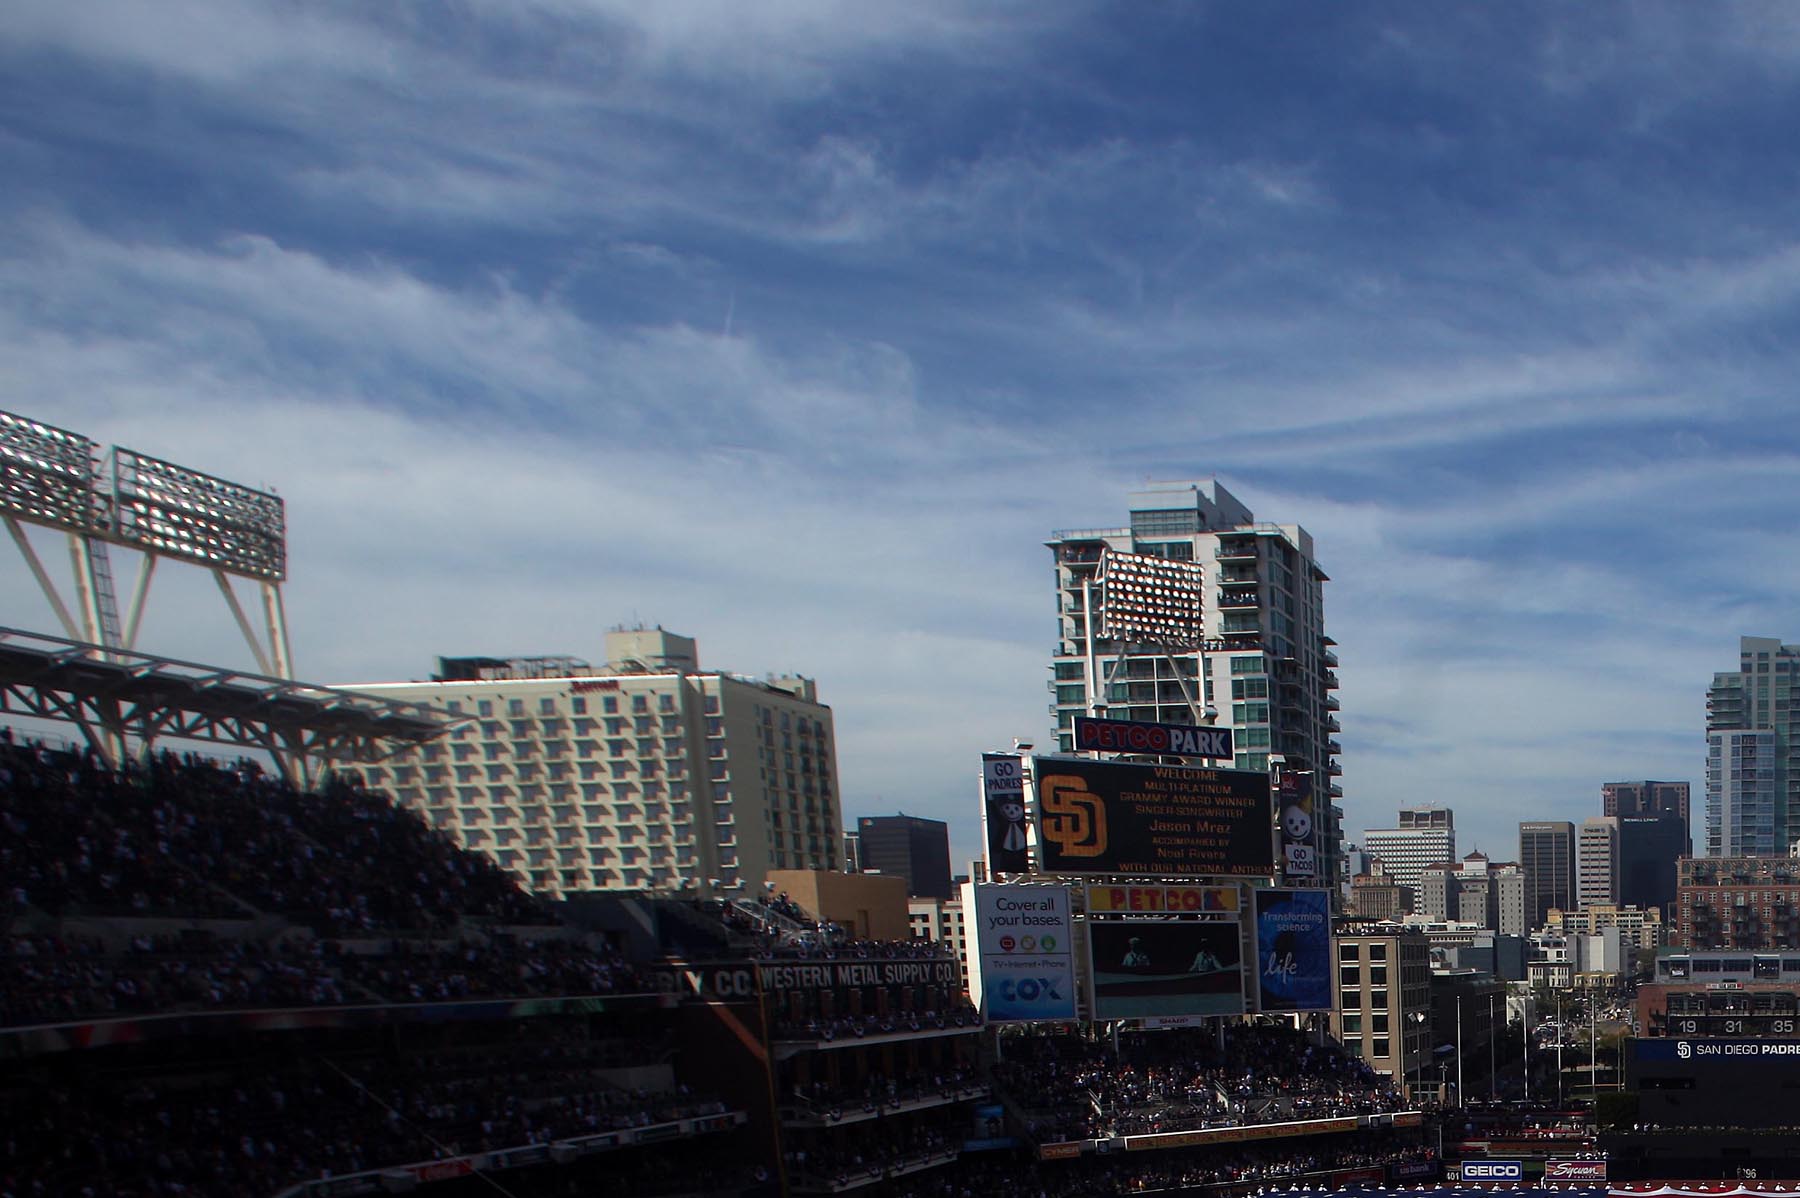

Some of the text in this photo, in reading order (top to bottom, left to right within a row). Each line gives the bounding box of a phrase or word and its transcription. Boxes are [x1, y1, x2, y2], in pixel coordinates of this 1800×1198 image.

[1081, 722, 1229, 756] PETCO PARK
[995, 762, 1014, 776] GO
[1154, 768, 1219, 781] WELCOME
[1120, 792, 1256, 807] GRAMMY AWARD WINNER
[1149, 819, 1232, 834] Jason Mraz
[1293, 848, 1308, 860] GO
[1119, 862, 1148, 873] WITH
[1151, 863, 1173, 873] OUR
[1177, 864, 1226, 874] NATIONAL
[1288, 859, 1314, 872] TACOS
[996, 897, 1055, 912] Cover all
[1110, 889, 1201, 911] PETCO
[989, 912, 1064, 931] your bases.
[1262, 911, 1323, 924] Transforming
[1276, 922, 1311, 932] science
[1264, 951, 1297, 984] life
[759, 963, 955, 989] WESTERN METAL SUPPLY CO.
[1680, 1020, 1697, 1033] 19
[1725, 1020, 1743, 1033] 31
[1774, 1020, 1793, 1033] 35
[1696, 1044, 1722, 1055] SAN
[1724, 1044, 1759, 1055] DIEGO
[1464, 1165, 1519, 1177] GEICO
[1552, 1162, 1600, 1179] Sycuan
